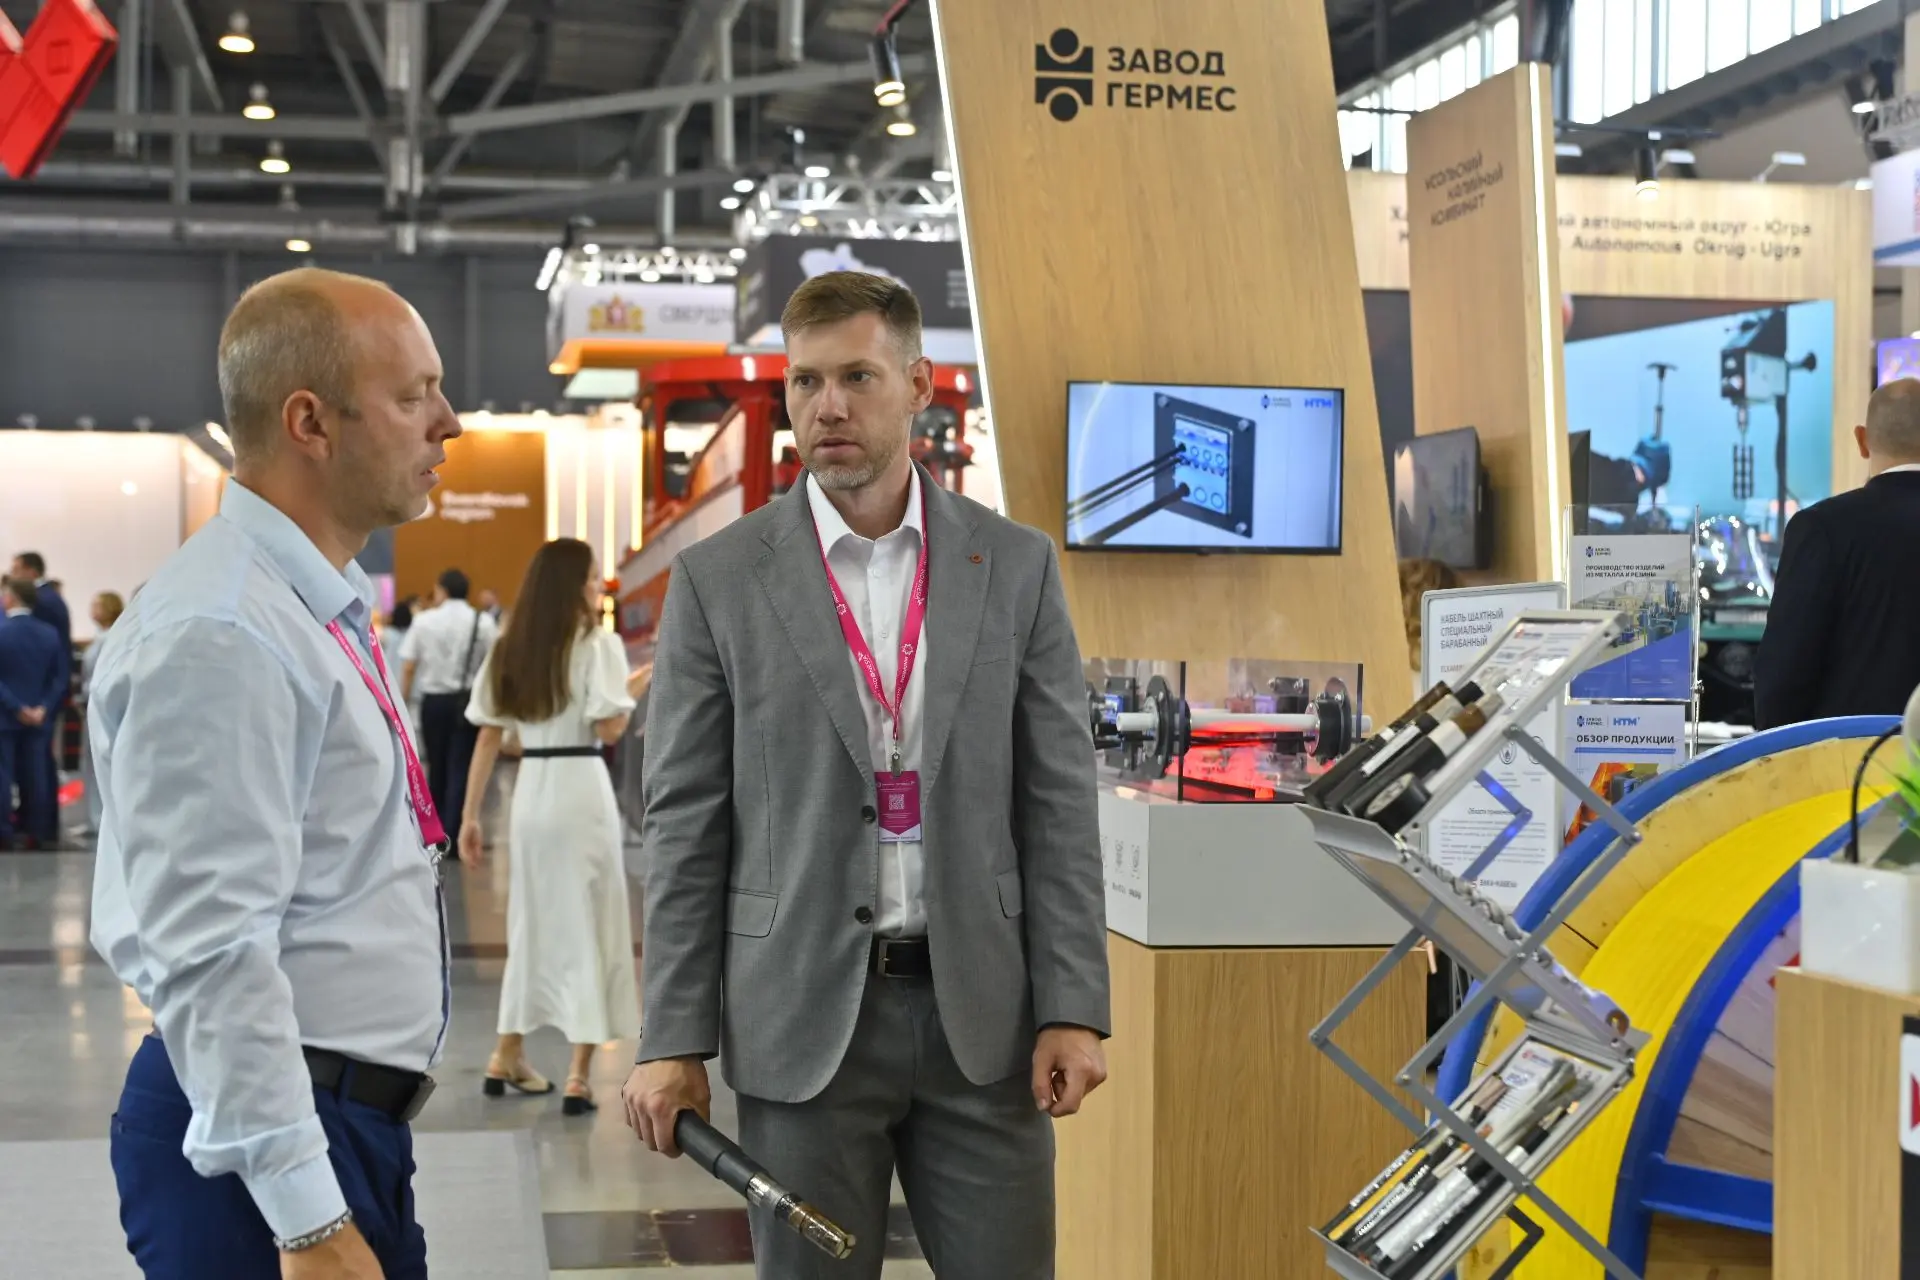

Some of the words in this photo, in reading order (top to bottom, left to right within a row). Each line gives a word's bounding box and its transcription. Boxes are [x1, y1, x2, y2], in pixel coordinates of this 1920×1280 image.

[1107, 47, 1226, 76] ЗАВОД
[1107, 82, 1237, 112] ГЕРМЕС
[1573, 236, 1684, 254] Autonomous
[1693, 238, 1747, 260] Okrug
[1761, 242, 1801, 261] Ugra
[1440, 613, 1467, 624] КАБЕЛЬ
[1467, 608, 1504, 621] ШАХТНЫЙ
[1440, 622, 1493, 637] СПЕЦИАЛЬНЫЙ
[1440, 635, 1488, 649] БАРАБАННЫЙ
[1576, 734, 1608, 743] ОБЗОР
[1611, 735, 1675, 745] ПРОДУКЦИИ
